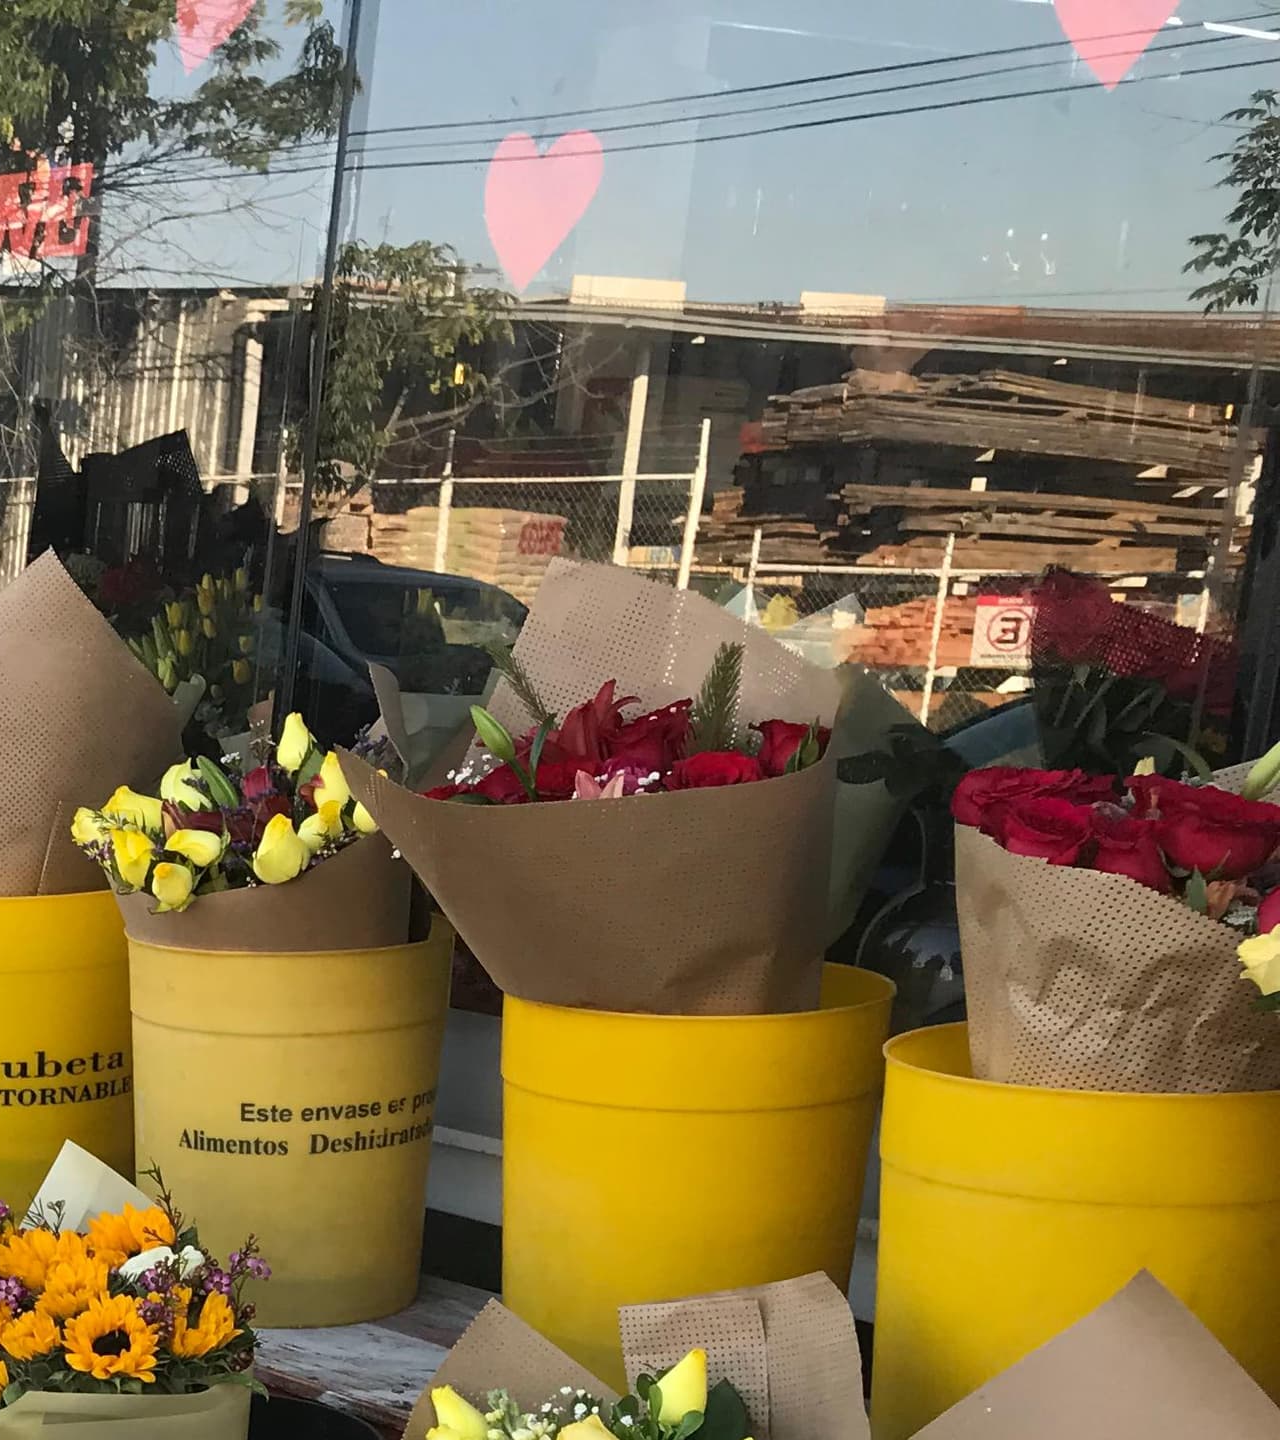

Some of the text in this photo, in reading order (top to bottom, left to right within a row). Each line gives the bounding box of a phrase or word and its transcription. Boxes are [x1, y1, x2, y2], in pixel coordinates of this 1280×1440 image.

[240, 1102, 292, 1123] Este
[301, 1101, 382, 1122] envase
[178, 1127, 289, 1156] Alimentos
